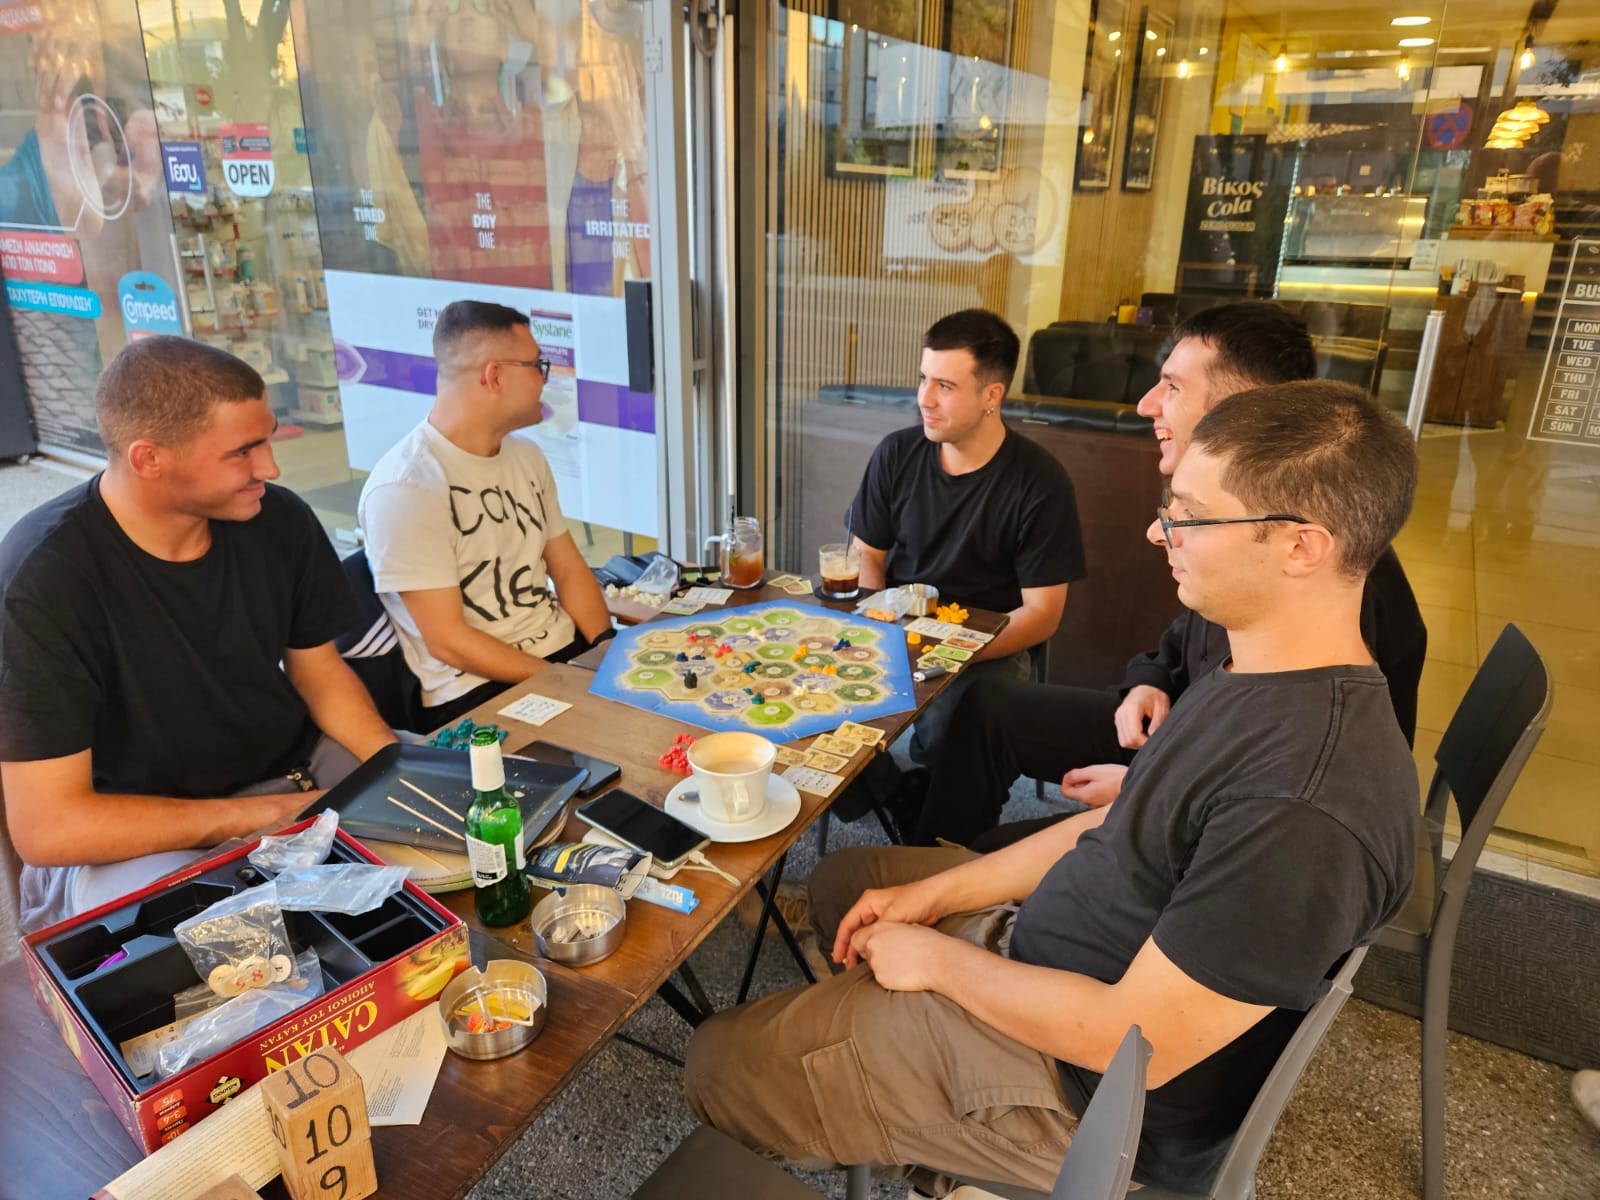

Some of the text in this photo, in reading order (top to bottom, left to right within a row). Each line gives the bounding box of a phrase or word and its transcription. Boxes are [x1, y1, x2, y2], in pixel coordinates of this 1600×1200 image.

[228, 164, 270, 185] OPEN
[474, 191, 492, 210] THE
[610, 198, 630, 217] THE
[1206, 197, 1253, 218] Cola
[352, 207, 385, 223] TIRED
[472, 213, 497, 229] DRY
[478, 231, 496, 249] ONE
[122, 294, 177, 324] Compeed
[1573, 321, 1600, 334] MON
[1571, 339, 1595, 351] TUE
[1566, 355, 1592, 367] WED
[1563, 372, 1587, 384] THU
[1560, 389, 1580, 400] FRI
[1554, 405, 1578, 416] SAT
[1550, 421, 1574, 432] SUN
[327, 980, 376, 1013] ΑΠΟΙΚΟΙ
[302, 1010, 326, 1028] ΤΟΥ
[264, 1000, 378, 1076] CATAN
[285, 1053, 340, 1110] 10
[306, 1104, 352, 1164] 10
[319, 1165, 348, 1200] 9
